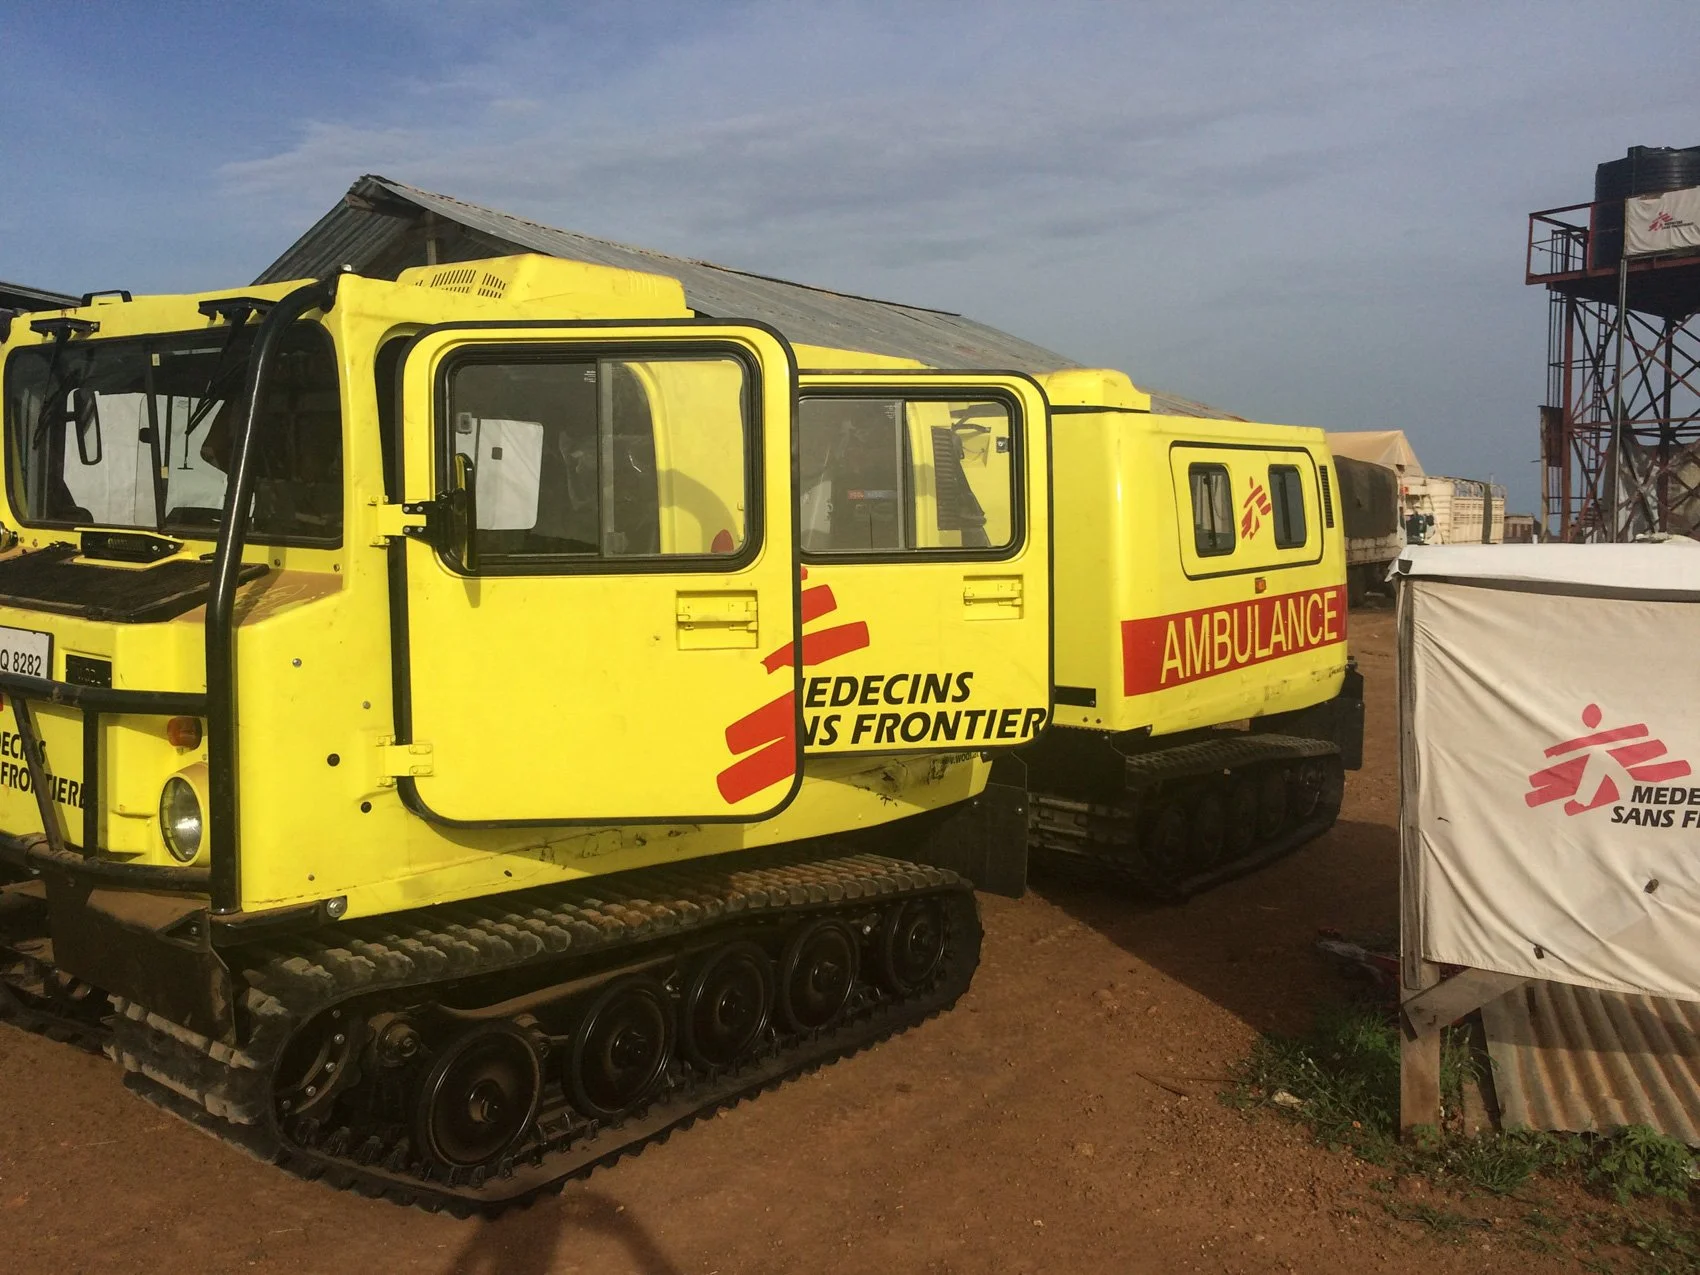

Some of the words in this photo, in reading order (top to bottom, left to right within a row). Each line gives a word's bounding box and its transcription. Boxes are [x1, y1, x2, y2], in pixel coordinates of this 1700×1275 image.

[1160, 591, 1337, 684] AMBULANCE
[0, 649, 9, 672] Q
[13, 651, 42, 677] 8282
[803, 672, 974, 708] EDECINS
[1611, 806, 1675, 828] SANS
